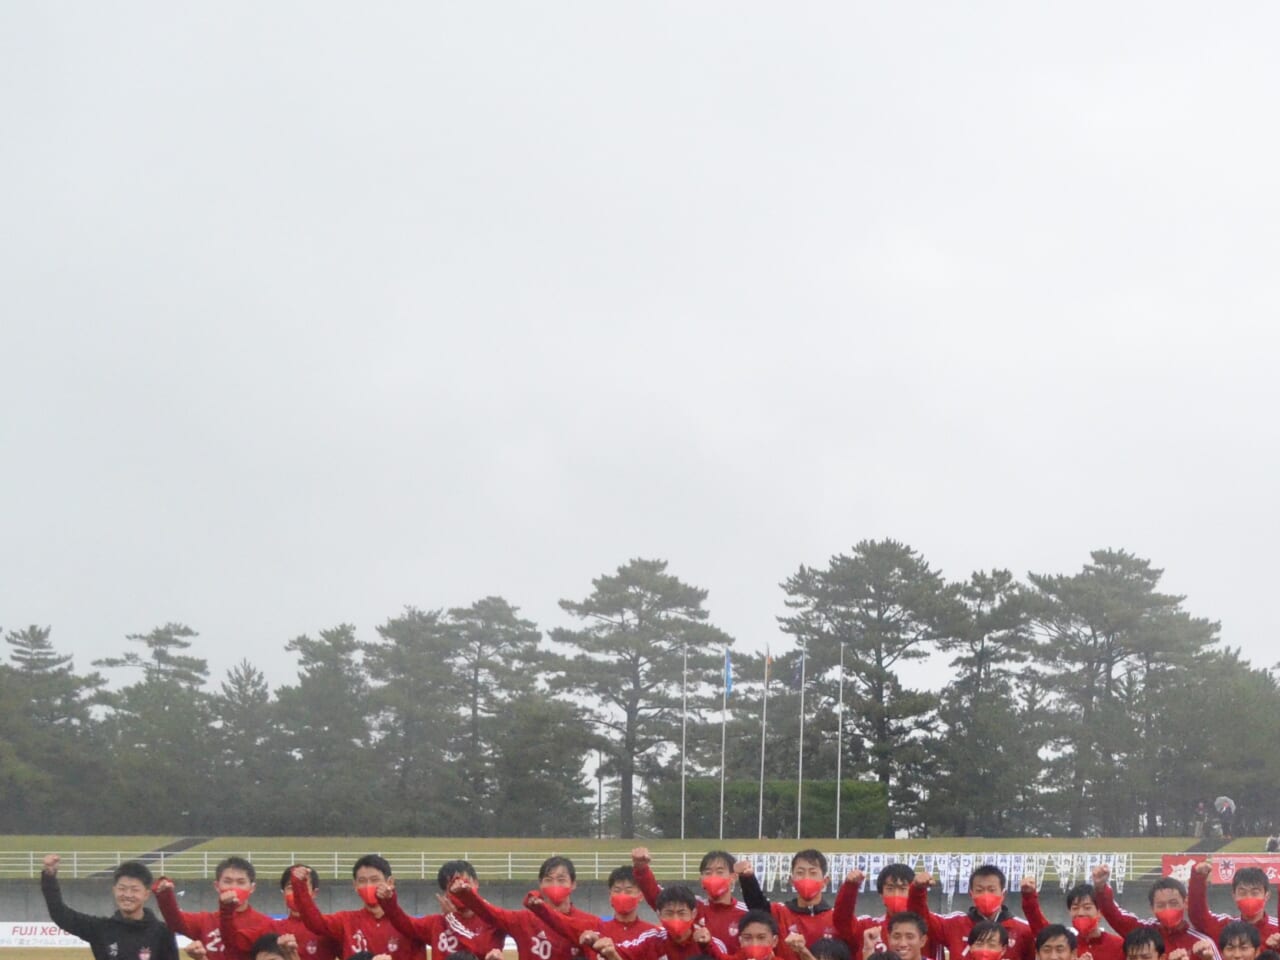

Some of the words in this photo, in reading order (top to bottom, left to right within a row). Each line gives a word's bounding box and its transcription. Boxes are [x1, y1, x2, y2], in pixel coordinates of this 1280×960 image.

[12, 926, 37, 936] FUJI
[438, 932, 458, 952] 82
[531, 936, 551, 960] 20
